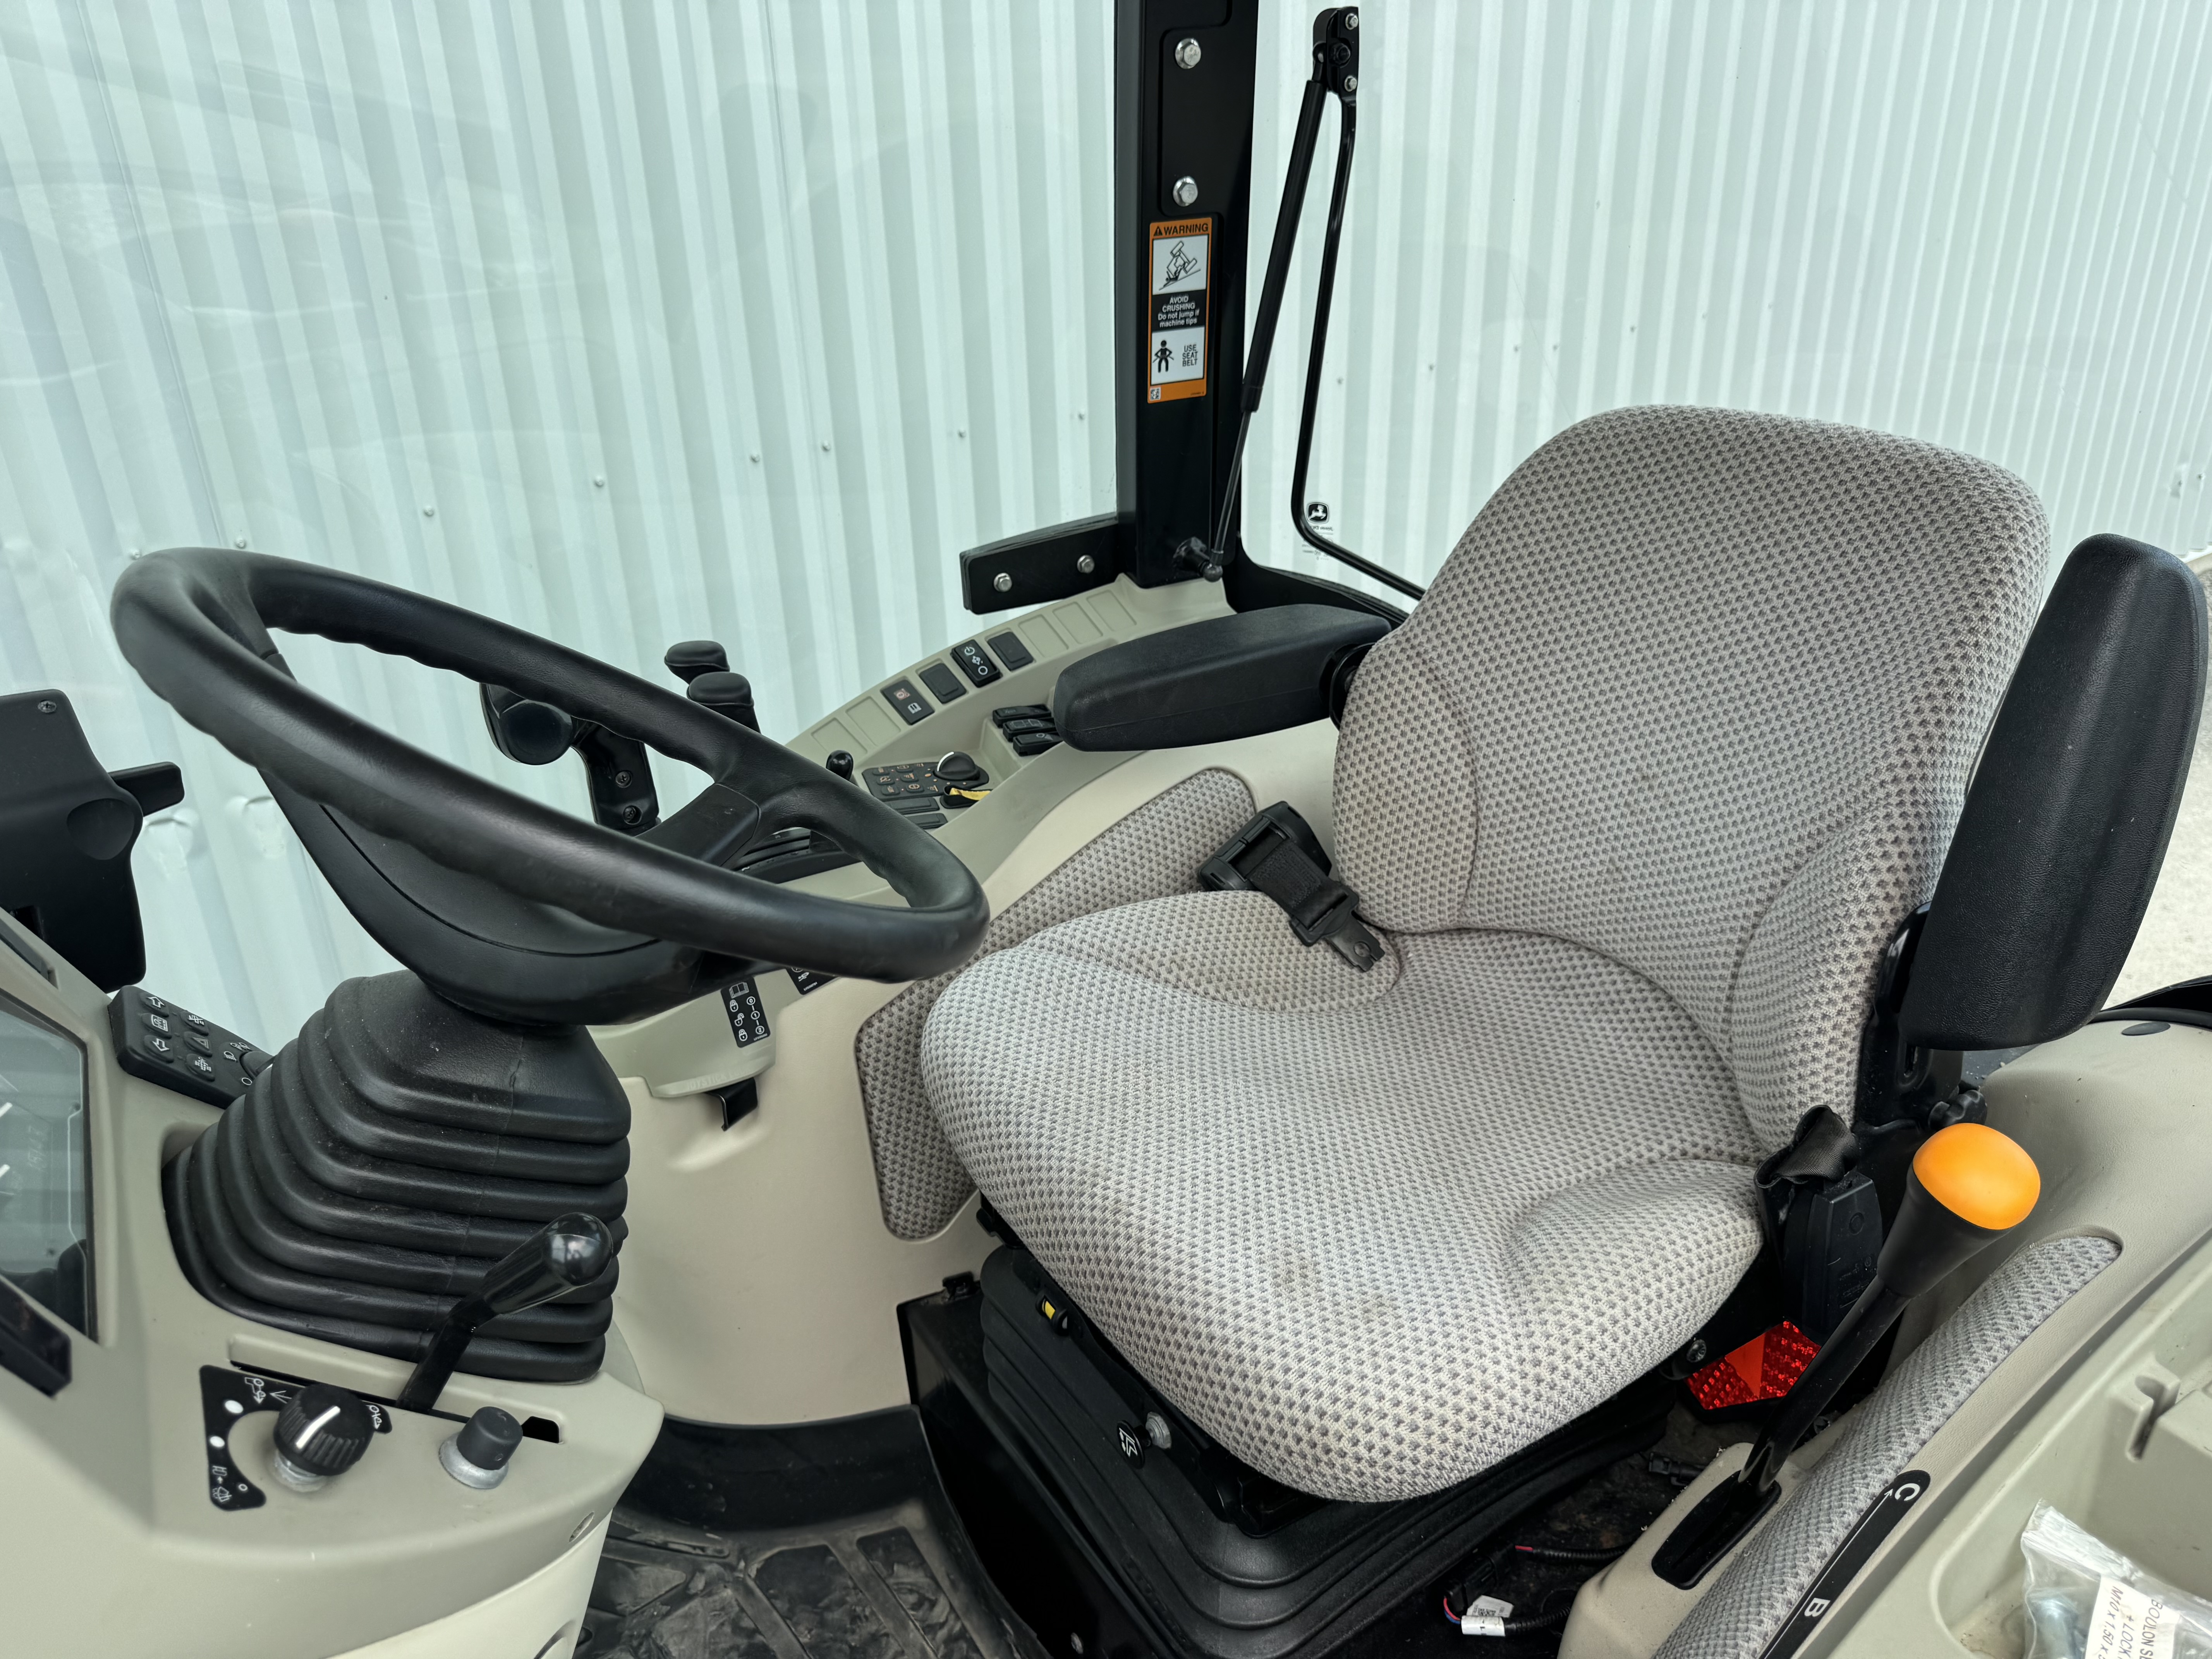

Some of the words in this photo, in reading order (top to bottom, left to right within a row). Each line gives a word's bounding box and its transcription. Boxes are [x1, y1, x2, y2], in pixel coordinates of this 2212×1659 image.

[1164, 223, 1208, 235] WARNING
[1170, 295, 1189, 304] AVOID
[1162, 302, 1195, 312] CRUSHING
[1178, 311, 1194, 319] jump
[1159, 319, 1185, 328] machine
[1186, 318, 1197, 326] tips
[1184, 344, 1197, 352] USE
[1182, 351, 1199, 360] SEAT
[1182, 358, 1198, 367] BELT
[1894, 1483, 1921, 1502] C
[2109, 1586, 2124, 1612] M10
[1803, 1597, 1831, 1618] B
[2141, 1599, 2163, 1647] BOULON
